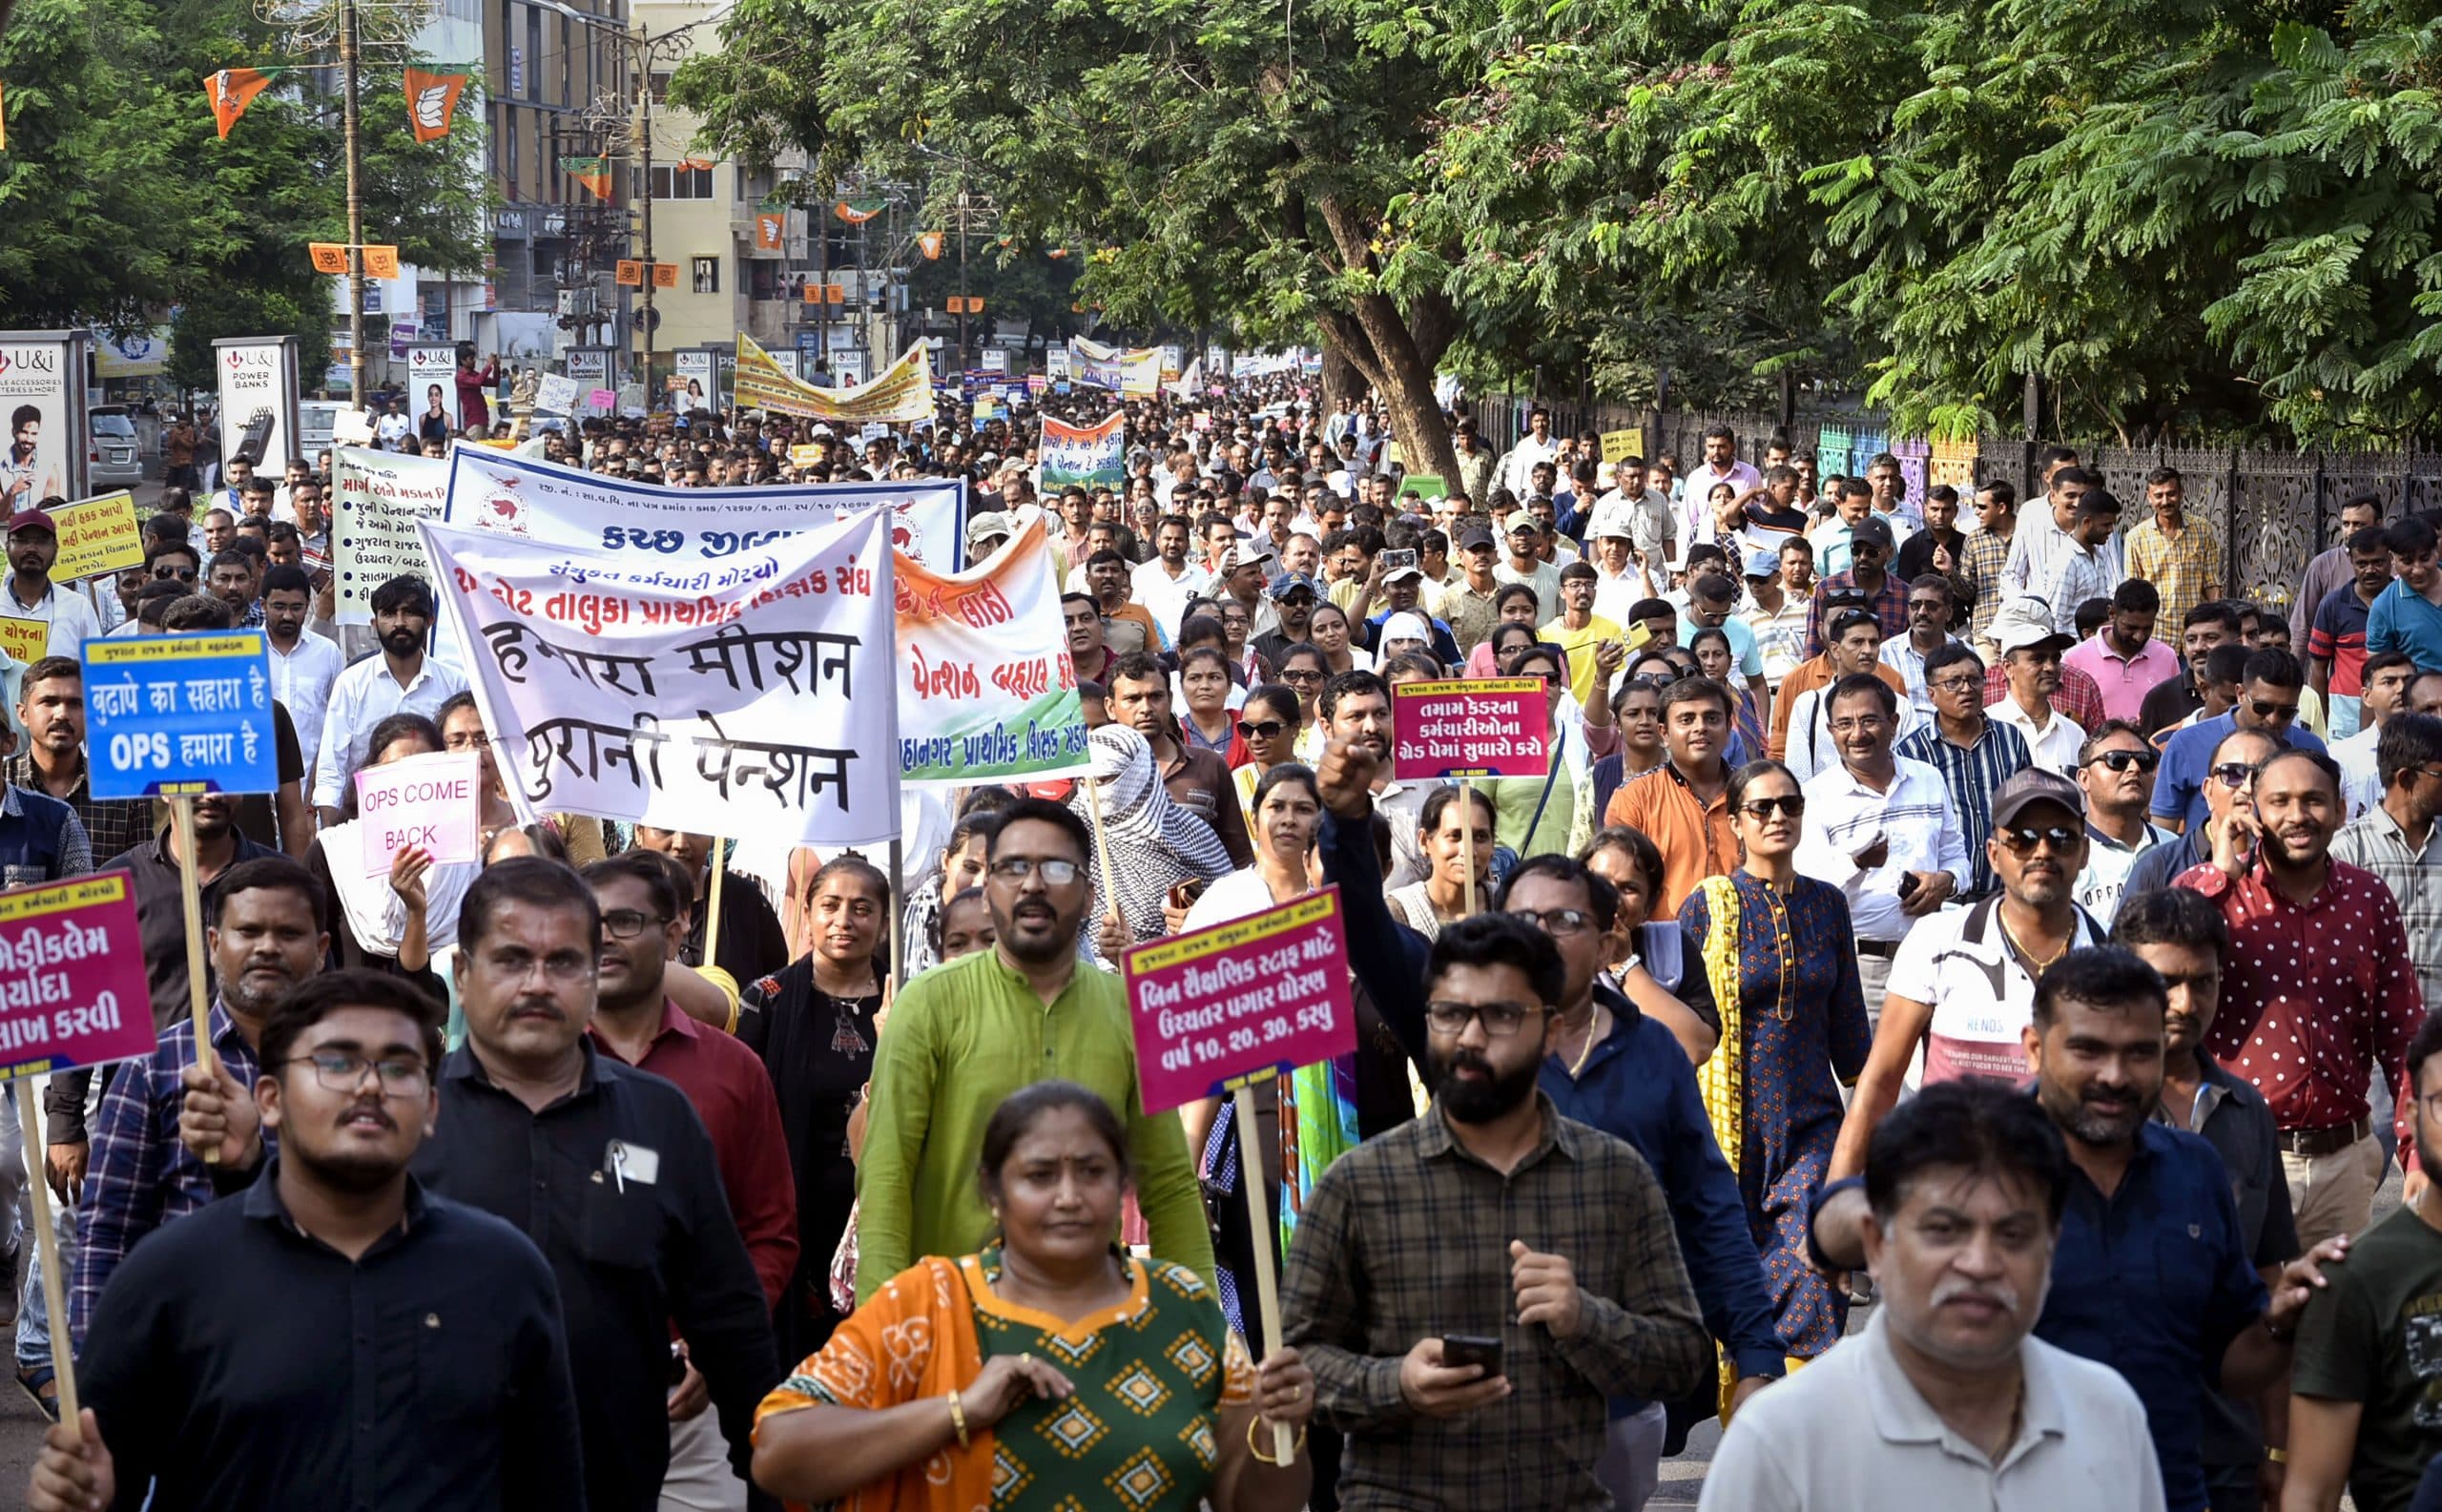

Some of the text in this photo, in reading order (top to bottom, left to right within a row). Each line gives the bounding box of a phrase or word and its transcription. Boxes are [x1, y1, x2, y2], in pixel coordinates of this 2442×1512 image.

[15, 350, 53, 373] U&i
[246, 351, 274, 367] U&i
[427, 350, 451, 364] U&i
[233, 371, 269, 380] POWER
[235, 381, 269, 389] BANKS
[341, 476, 370, 494] માર્ગ
[373, 482, 396, 497] અને
[399, 487, 433, 500] મકાન
[354, 537, 391, 551] ગુજરાત
[545, 592, 629, 636] તાલુકા
[835, 553, 871, 597] સંઘ
[911, 643, 981, 700] પેન્શન
[147, 682, 178, 715] का
[184, 678, 242, 713] सहारा
[248, 663, 267, 710] है
[1418, 695, 1520, 717] તમામ કેડરના
[1418, 715, 1521, 738] કર્મચારીઓના
[110, 718, 259, 772] OPS हमारा है
[525, 712, 673, 802] पुरानी
[899, 736, 954, 773] હાનગર
[962, 721, 1018, 767] પ્રાથમિક
[1397, 735, 1542, 762] ગ્રેડ પેમાં સુધારો કરો
[364, 779, 468, 812] OPS COME
[385, 824, 437, 850] BACK
[1138, 980, 1181, 1012] બિન
[1301, 925, 1336, 960] માટે
[1227, 987, 1276, 1018] પગાર
[1277, 968, 1327, 1004] ધોરણ
[53, 989, 123, 1040] કરવી
[1161, 1037, 1191, 1071] વર્ષ
